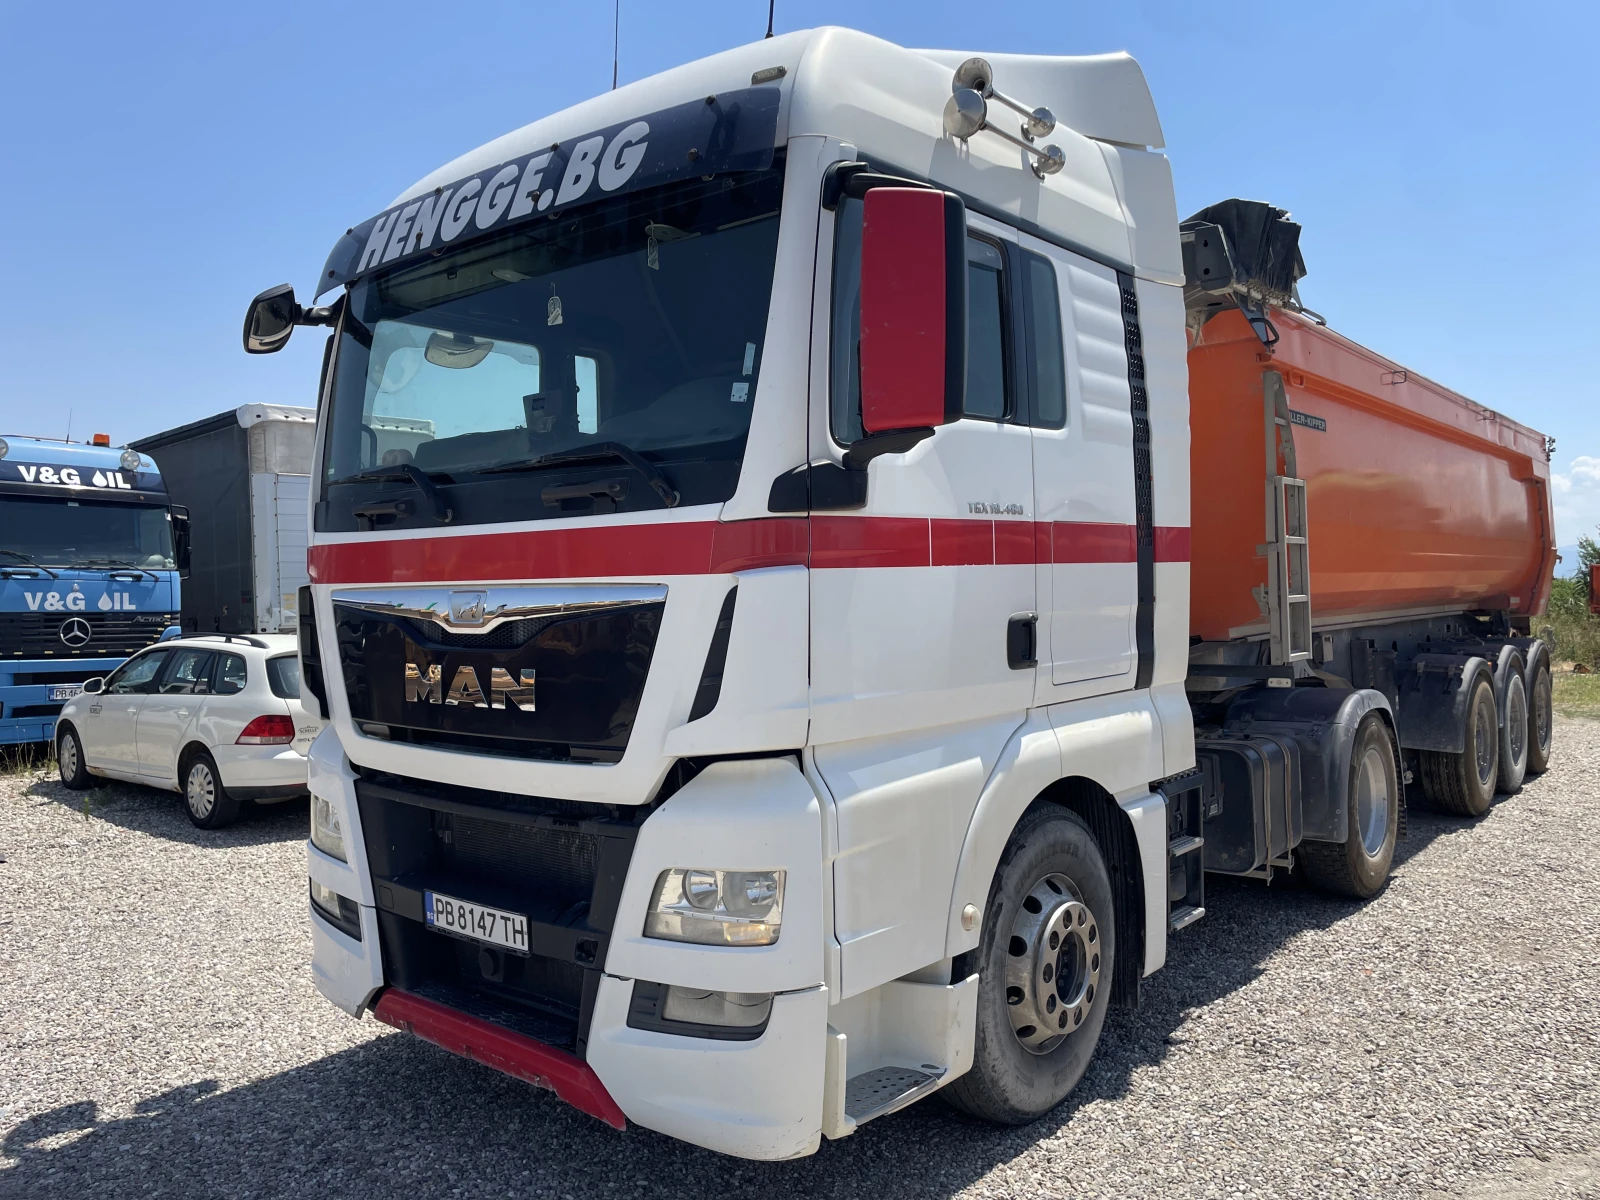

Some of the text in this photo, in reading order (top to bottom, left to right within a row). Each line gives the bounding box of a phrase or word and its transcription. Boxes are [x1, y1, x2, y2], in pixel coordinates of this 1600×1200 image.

[356, 121, 650, 274] HENGGE.BG
[17, 466, 81, 485] V&G
[24, 592, 86, 611] V&G
[55, 690, 67, 698] PB
[405, 663, 536, 712] MAN
[435, 898, 455, 927] PB
[457, 905, 497, 938] 8147
[500, 915, 525, 946] TH
